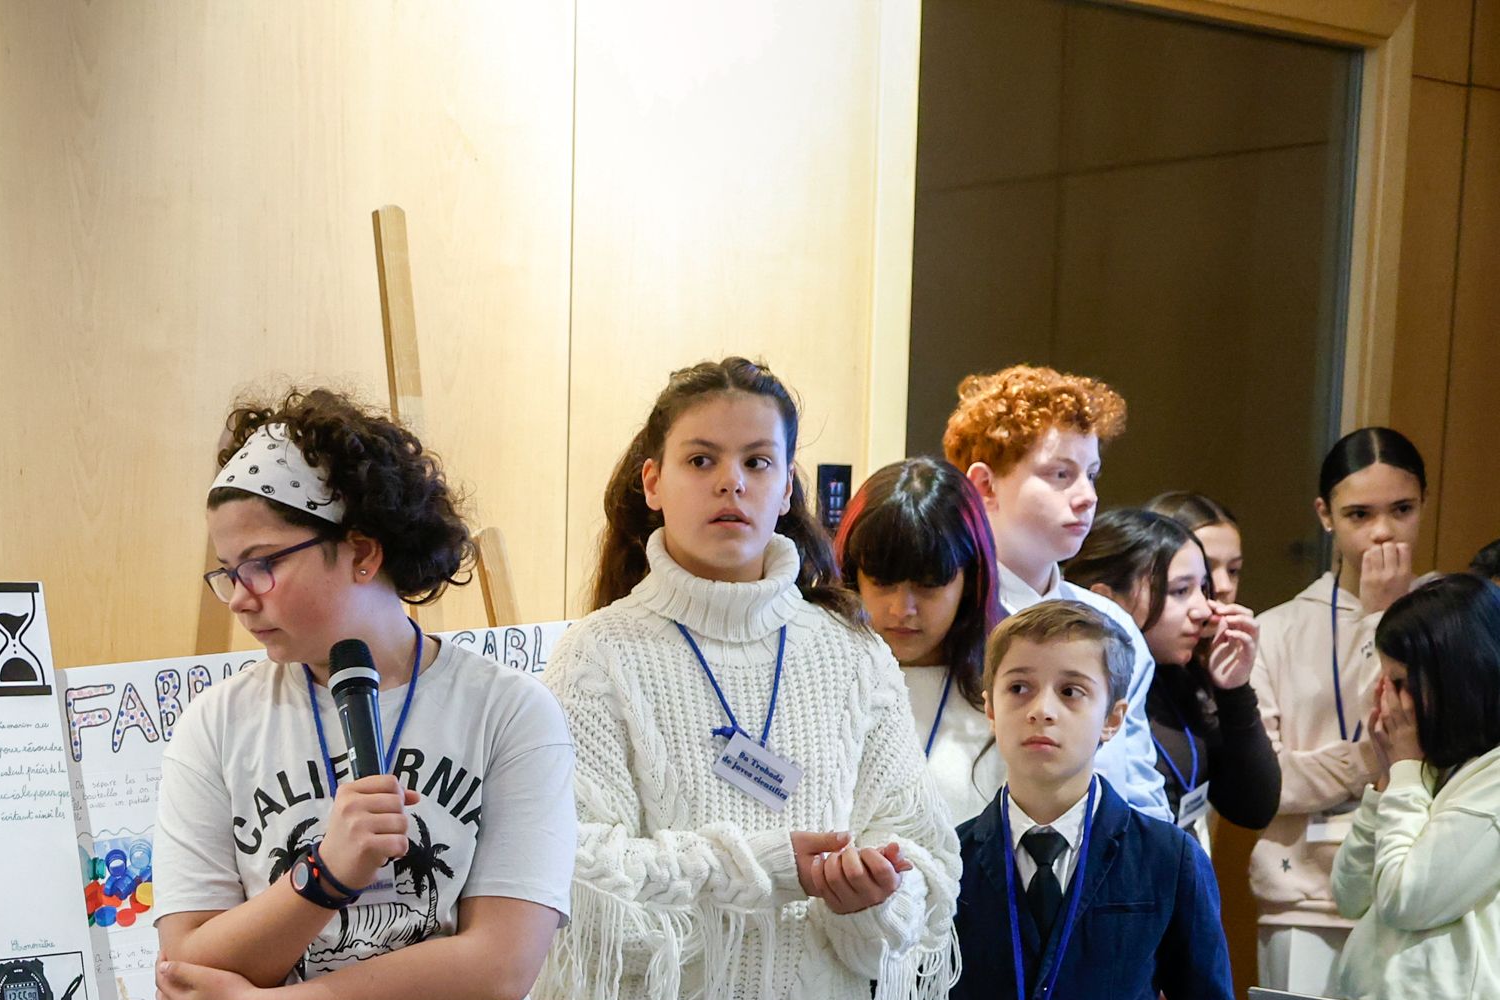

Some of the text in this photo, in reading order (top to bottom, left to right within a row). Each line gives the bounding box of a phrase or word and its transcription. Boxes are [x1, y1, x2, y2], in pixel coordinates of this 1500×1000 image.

[451, 625, 572, 673] ABL
[65, 660, 257, 763] FAB
[233, 747, 484, 855] CALIFRNIA
